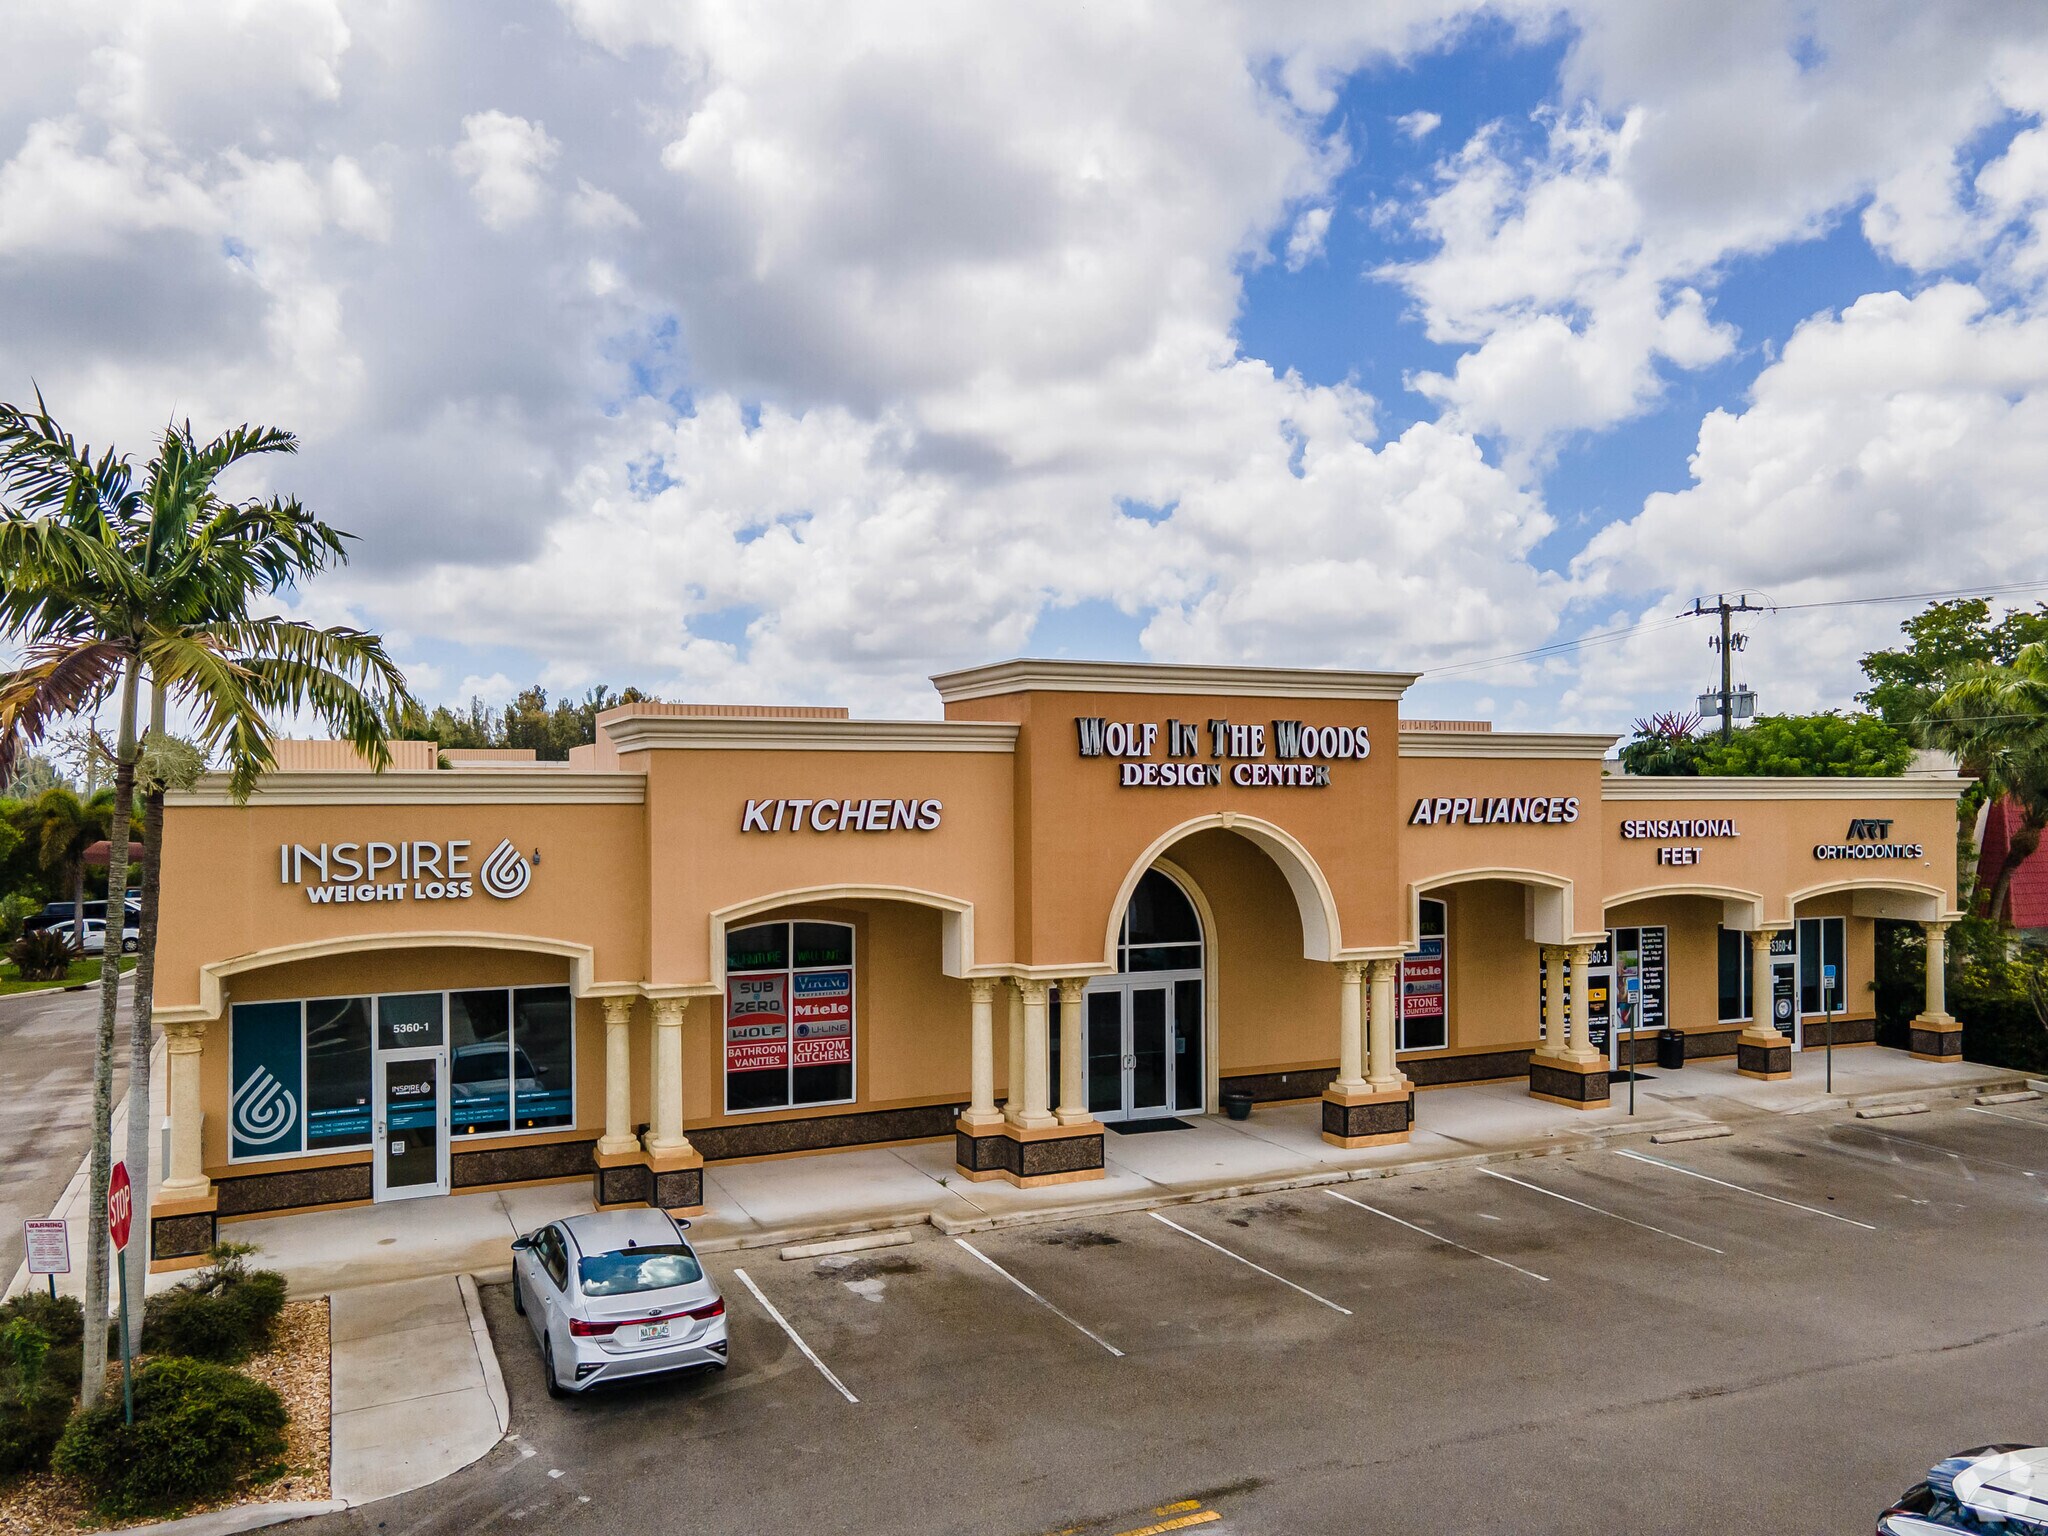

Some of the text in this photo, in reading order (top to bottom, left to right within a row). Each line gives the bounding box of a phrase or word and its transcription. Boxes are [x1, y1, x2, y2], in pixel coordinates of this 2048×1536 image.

[1075, 717, 1371, 760] WOLF IN THE WOODS
[1119, 763, 1332, 787] DESIGN CENTER
[741, 799, 943, 832] KITCHENS
[1408, 796, 1580, 826] APPLIANCES
[1622, 819, 1741, 839] SENSATIONAL
[1846, 818, 1894, 840] ART
[1658, 847, 1703, 866] FEET
[1814, 844, 1924, 860] ORTHODONTICS
[281, 840, 472, 883] INSPIRE
[306, 881, 474, 903] WEIGHT LOSS
[1404, 966, 1441, 976] Miele
[740, 981, 774, 994] SUB
[735, 1000, 780, 1013] ZERO
[795, 1003, 849, 1016] Miele
[1407, 997, 1438, 1008] STONE
[393, 1022, 429, 1033] 5360-1
[732, 1026, 783, 1038] WOLF
[811, 1024, 847, 1034] U-LINE
[728, 1045, 787, 1058] BATHROOM
[797, 1040, 846, 1053] CUSTOM
[735, 1055, 780, 1067] VANITIES
[794, 1049, 850, 1063] KITCHENS
[110, 1184, 130, 1228] STOP
